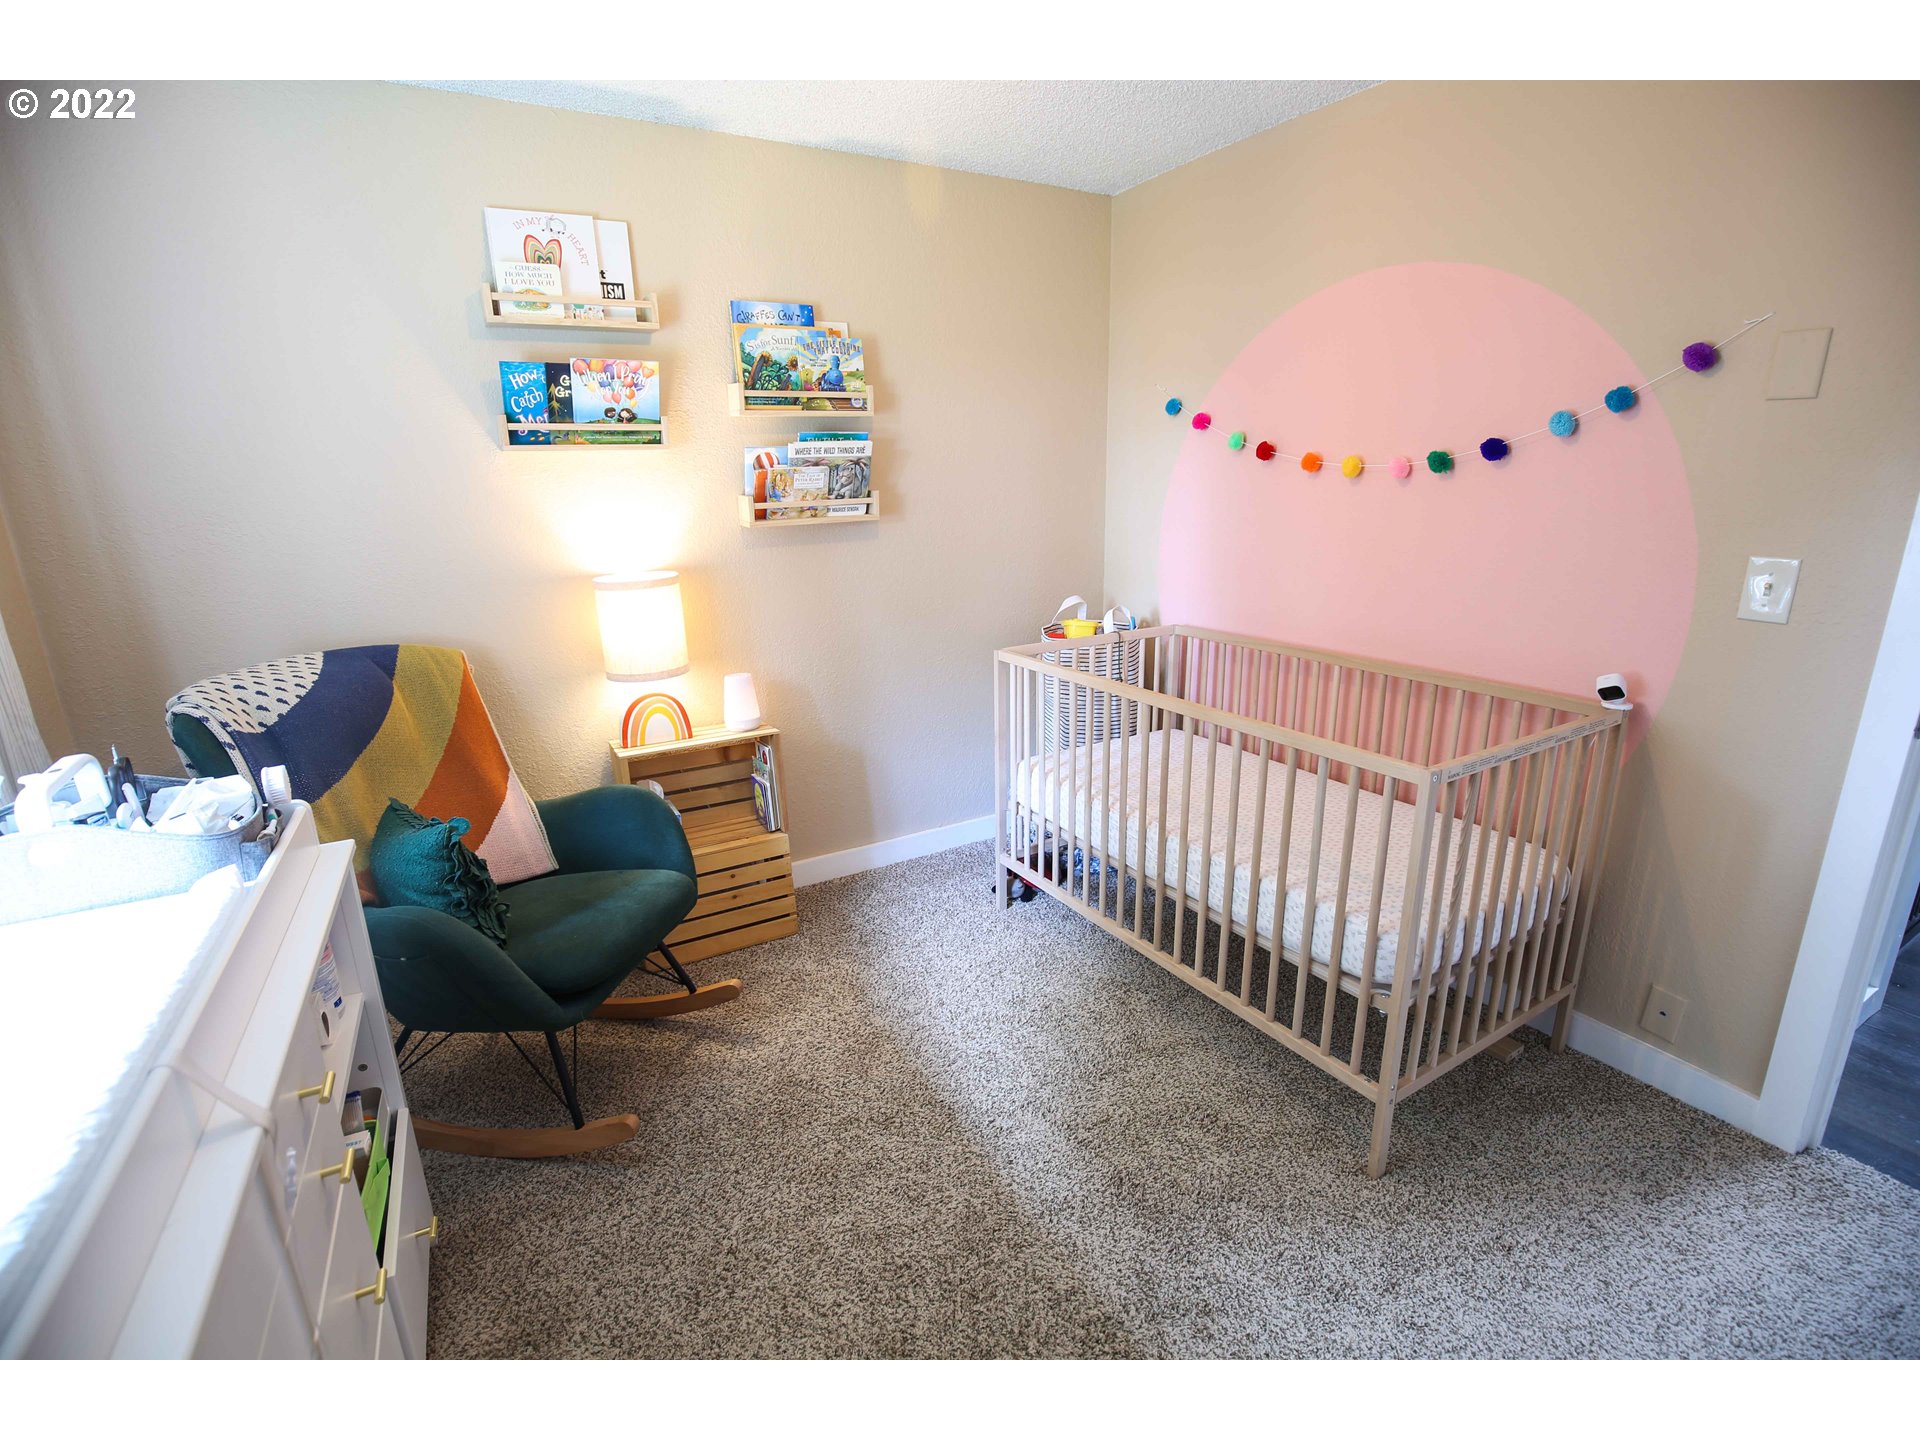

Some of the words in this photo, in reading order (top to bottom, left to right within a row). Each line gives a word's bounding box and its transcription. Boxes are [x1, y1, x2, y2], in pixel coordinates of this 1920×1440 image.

[512, 219, 525, 231] IN
[526, 216, 542, 226] MY
[567, 233, 590, 266] HEART
[736, 310, 776, 323] GIRAFFES
[508, 369, 538, 390] How
[576, 367, 612, 386] When
[620, 365, 650, 392] Pray
[511, 387, 544, 413] Catch
[795, 447, 812, 455] WHERE
[813, 447, 823, 455] THE
[823, 446, 836, 455] WILD
[837, 446, 855, 454] THINGS
[855, 446, 866, 454] ARE
